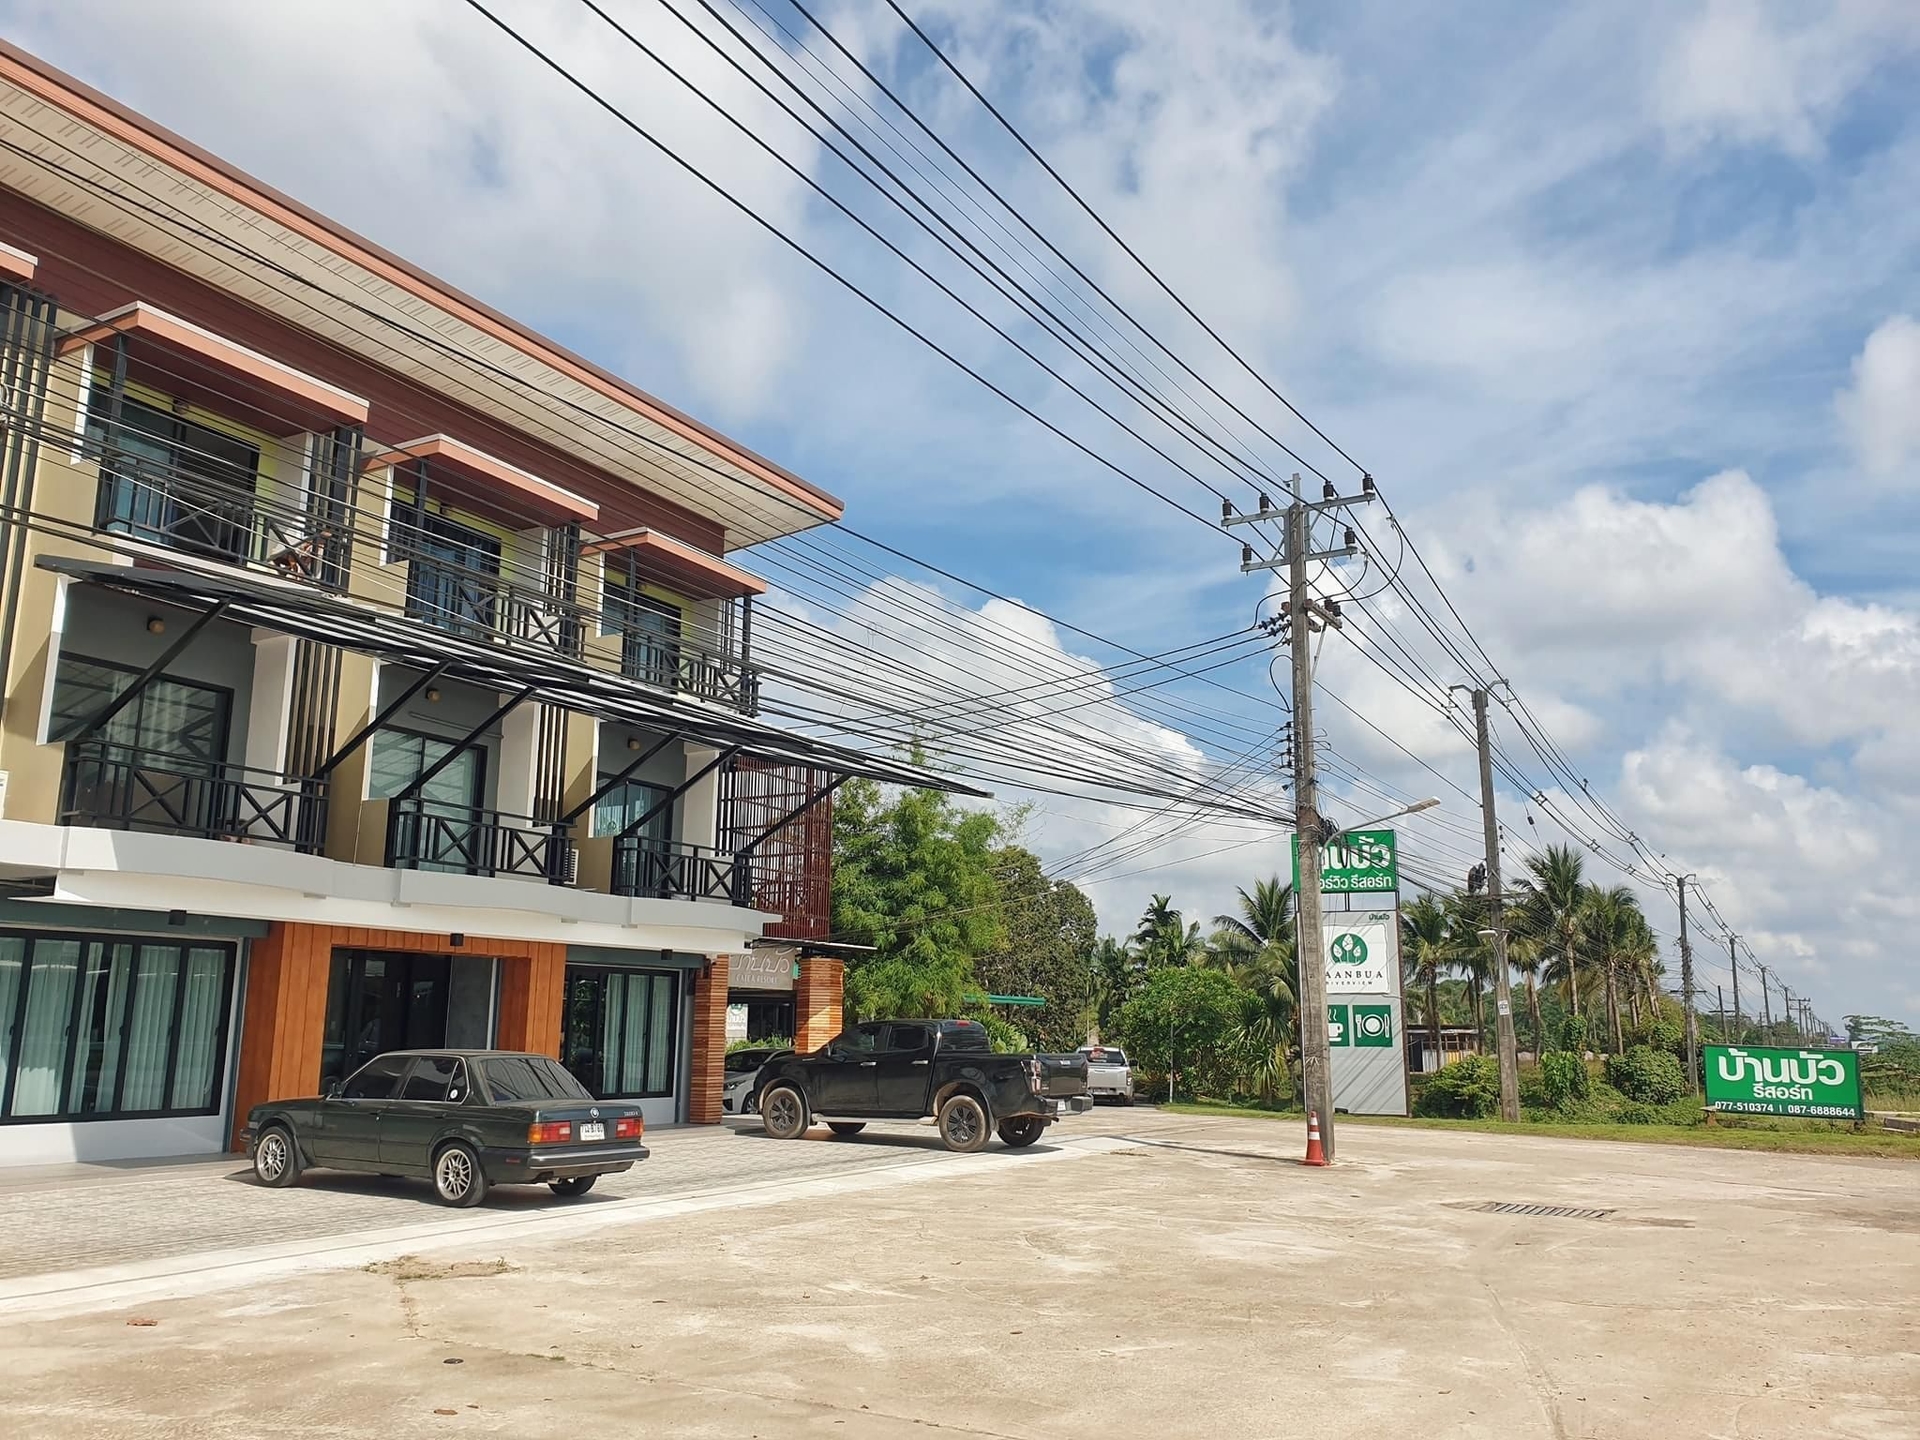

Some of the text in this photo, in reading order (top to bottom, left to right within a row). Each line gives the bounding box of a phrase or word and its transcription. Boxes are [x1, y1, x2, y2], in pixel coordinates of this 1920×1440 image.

[1318, 836, 1391, 871] านบัว
[1350, 873, 1392, 888] รีสอร์ท
[1325, 970, 1383, 979] AANBUA
[1718, 1048, 1845, 1086] บ้านบัว
[1753, 1082, 1813, 1100] รีสอร์ท
[1715, 1101, 1774, 1112] 077-510374
[1788, 1104, 1855, 1116] 087-6888644
